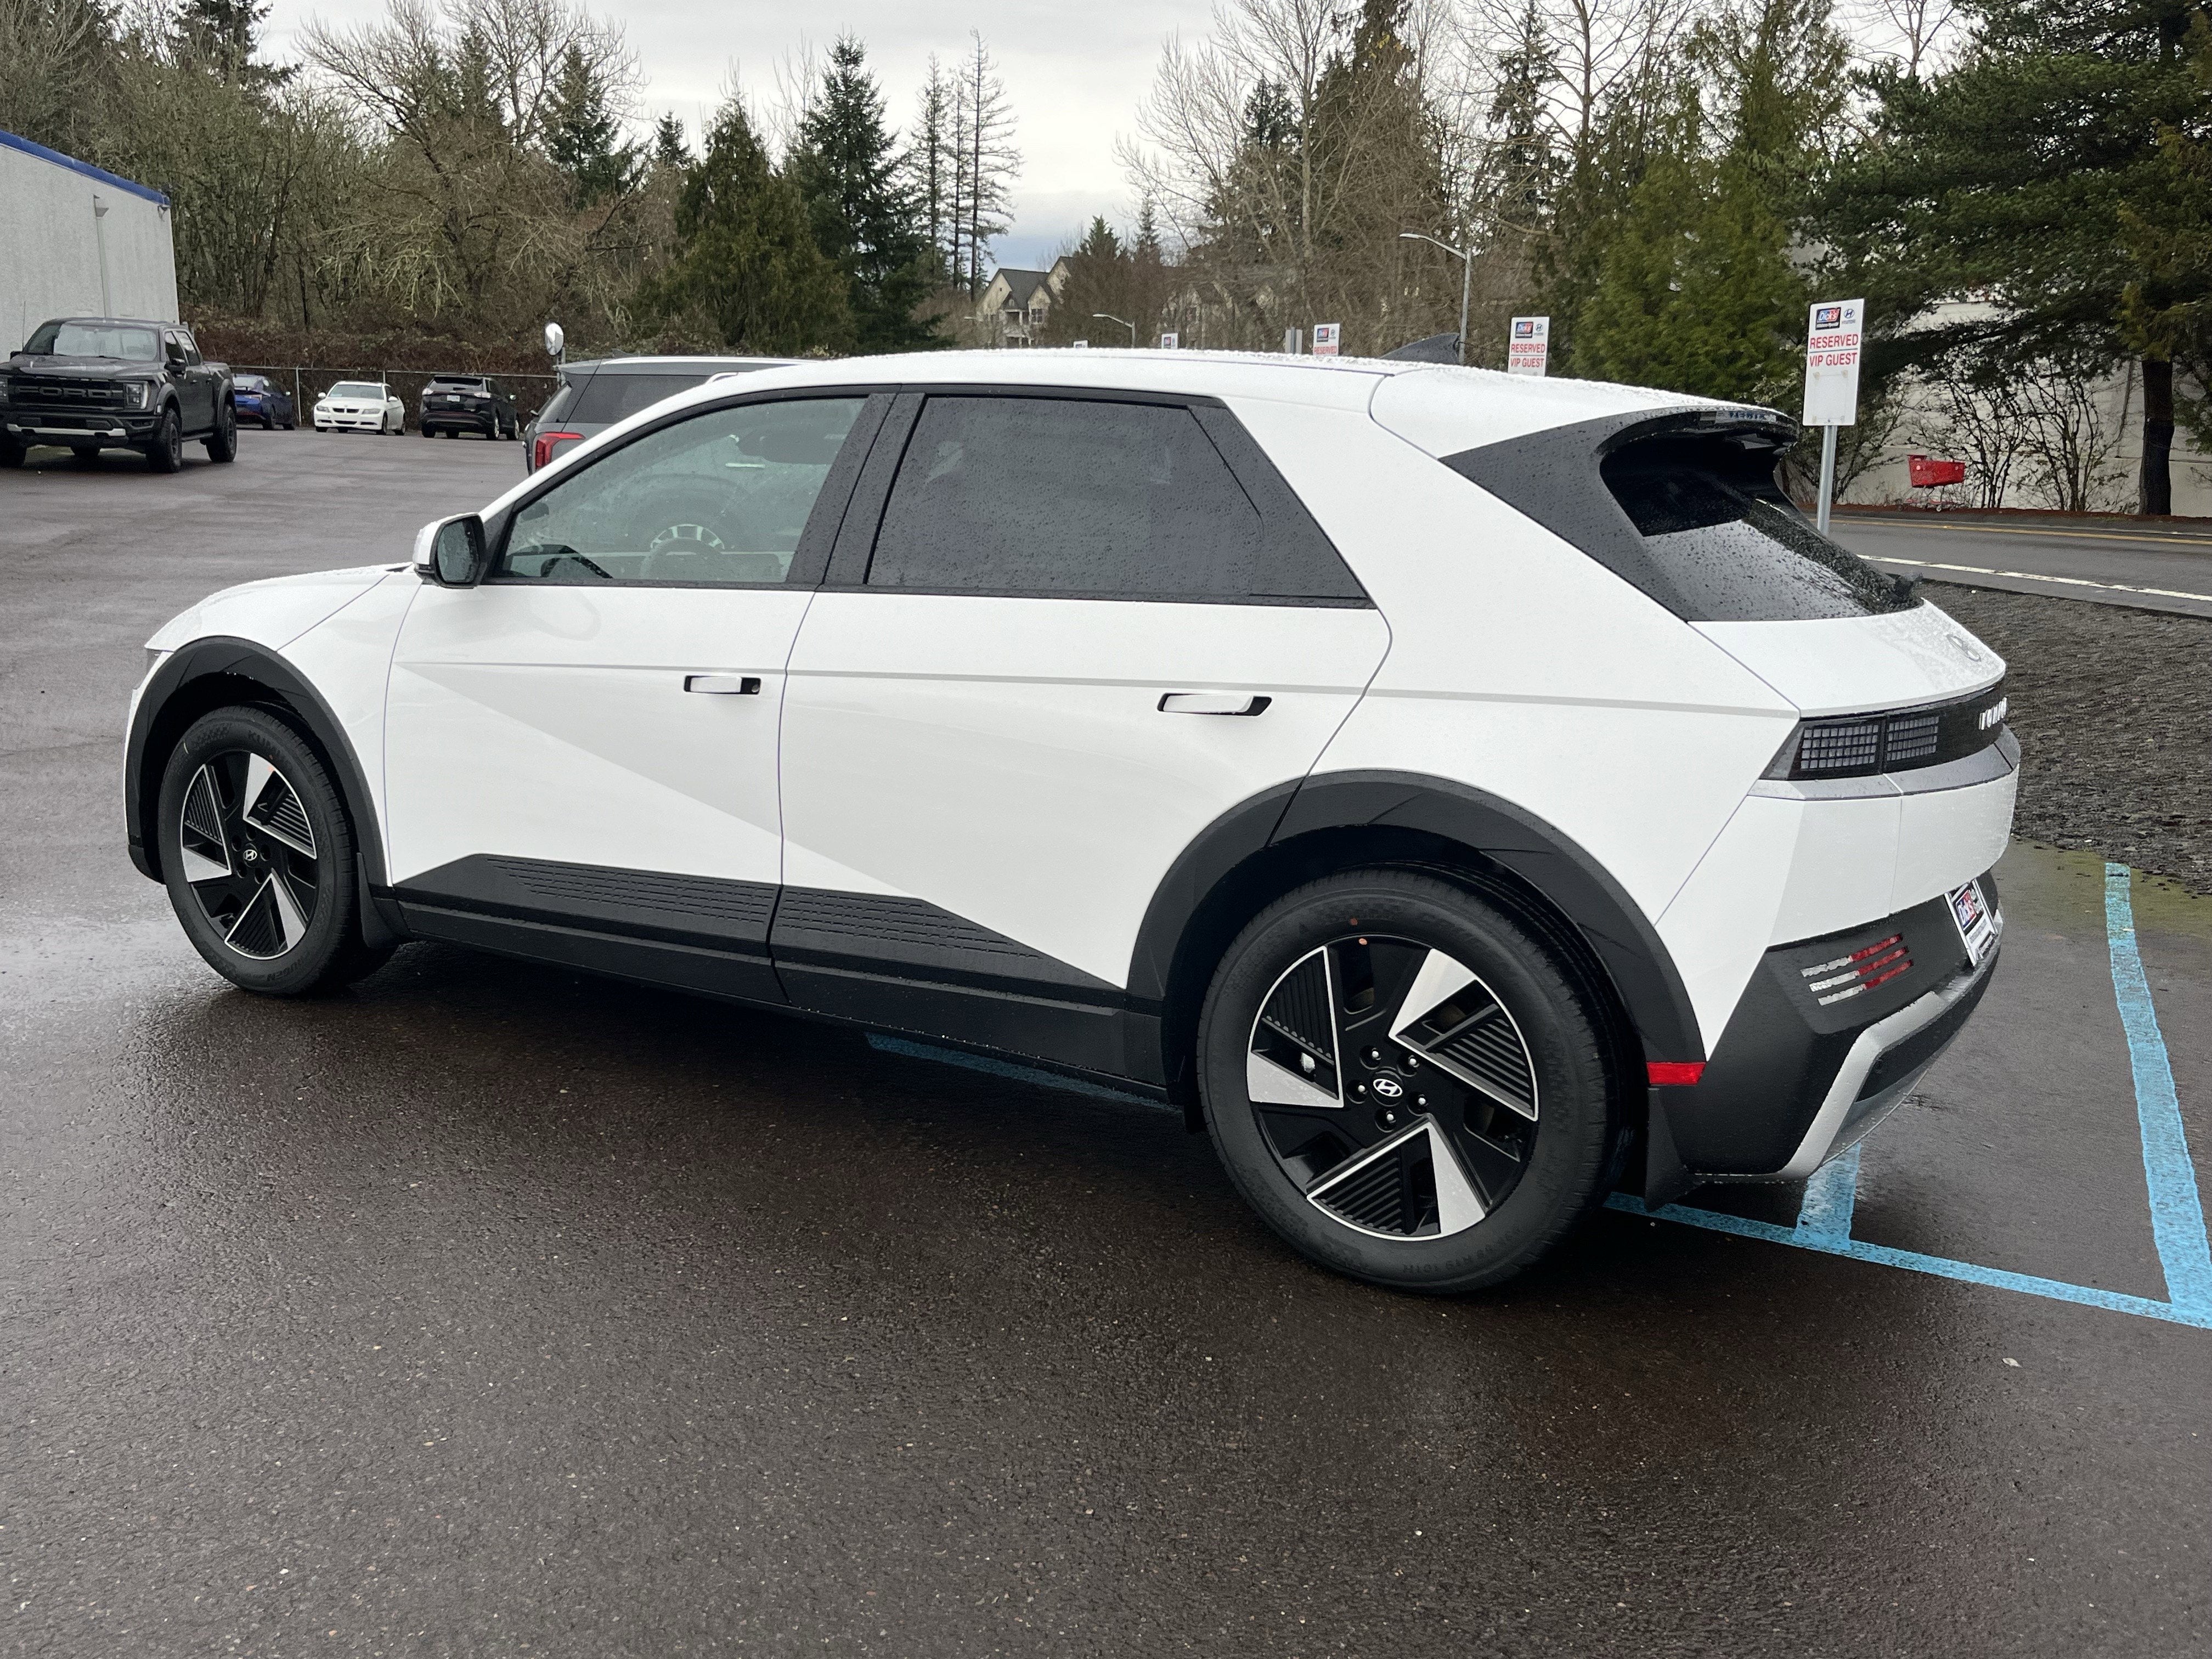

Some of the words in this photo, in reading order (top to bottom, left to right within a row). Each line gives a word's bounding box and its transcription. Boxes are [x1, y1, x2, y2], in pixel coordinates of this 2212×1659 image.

[1511, 343, 1545, 353] RESERVED
[1809, 334, 1859, 349] RESERVED
[1510, 358, 1521, 367] VIP
[1522, 358, 1544, 368] GUEST
[1809, 354, 1823, 367] VIP
[1826, 352, 1858, 366] GUEST
[14, 385, 111, 399] FORD
